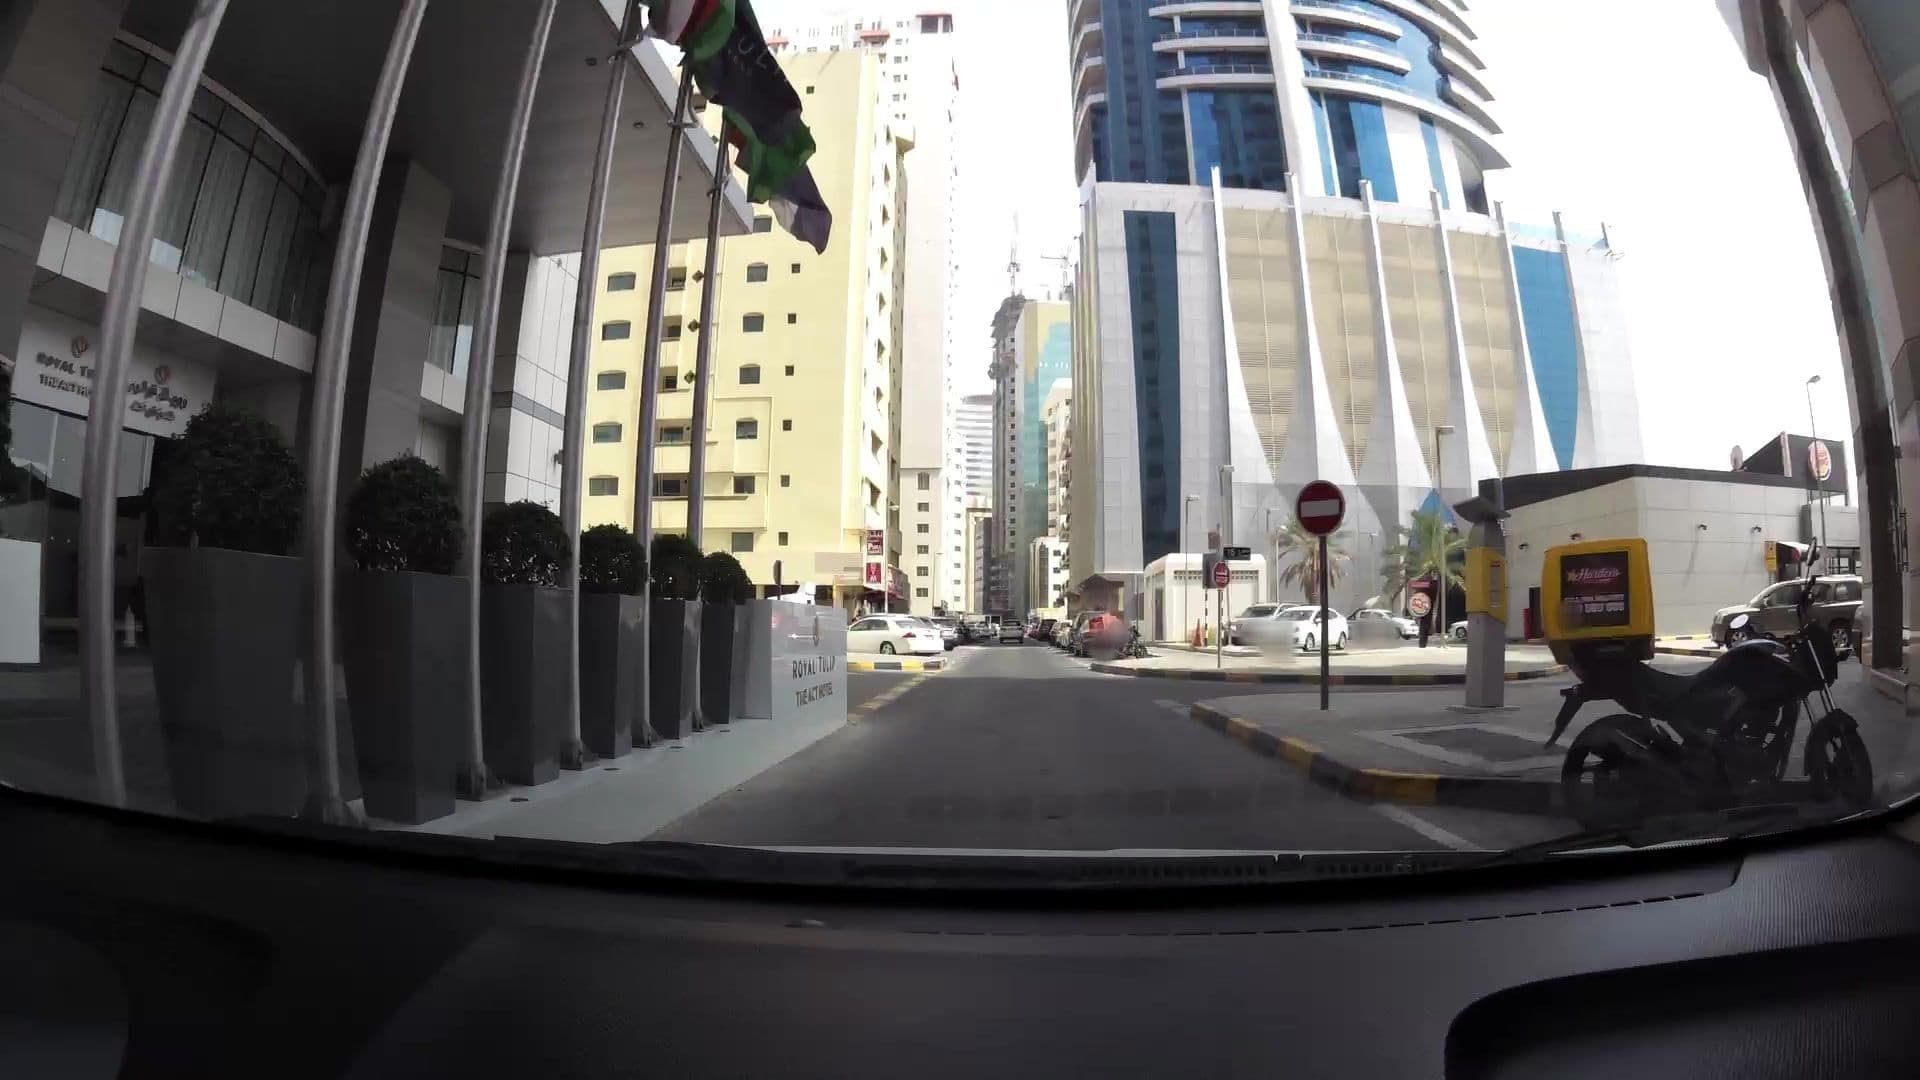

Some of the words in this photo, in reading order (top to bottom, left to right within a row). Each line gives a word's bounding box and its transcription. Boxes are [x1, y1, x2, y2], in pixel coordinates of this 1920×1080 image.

[792, 659, 815, 680] ROYAL
[817, 656, 836, 673] TULIP
[796, 688, 808, 708] THE
